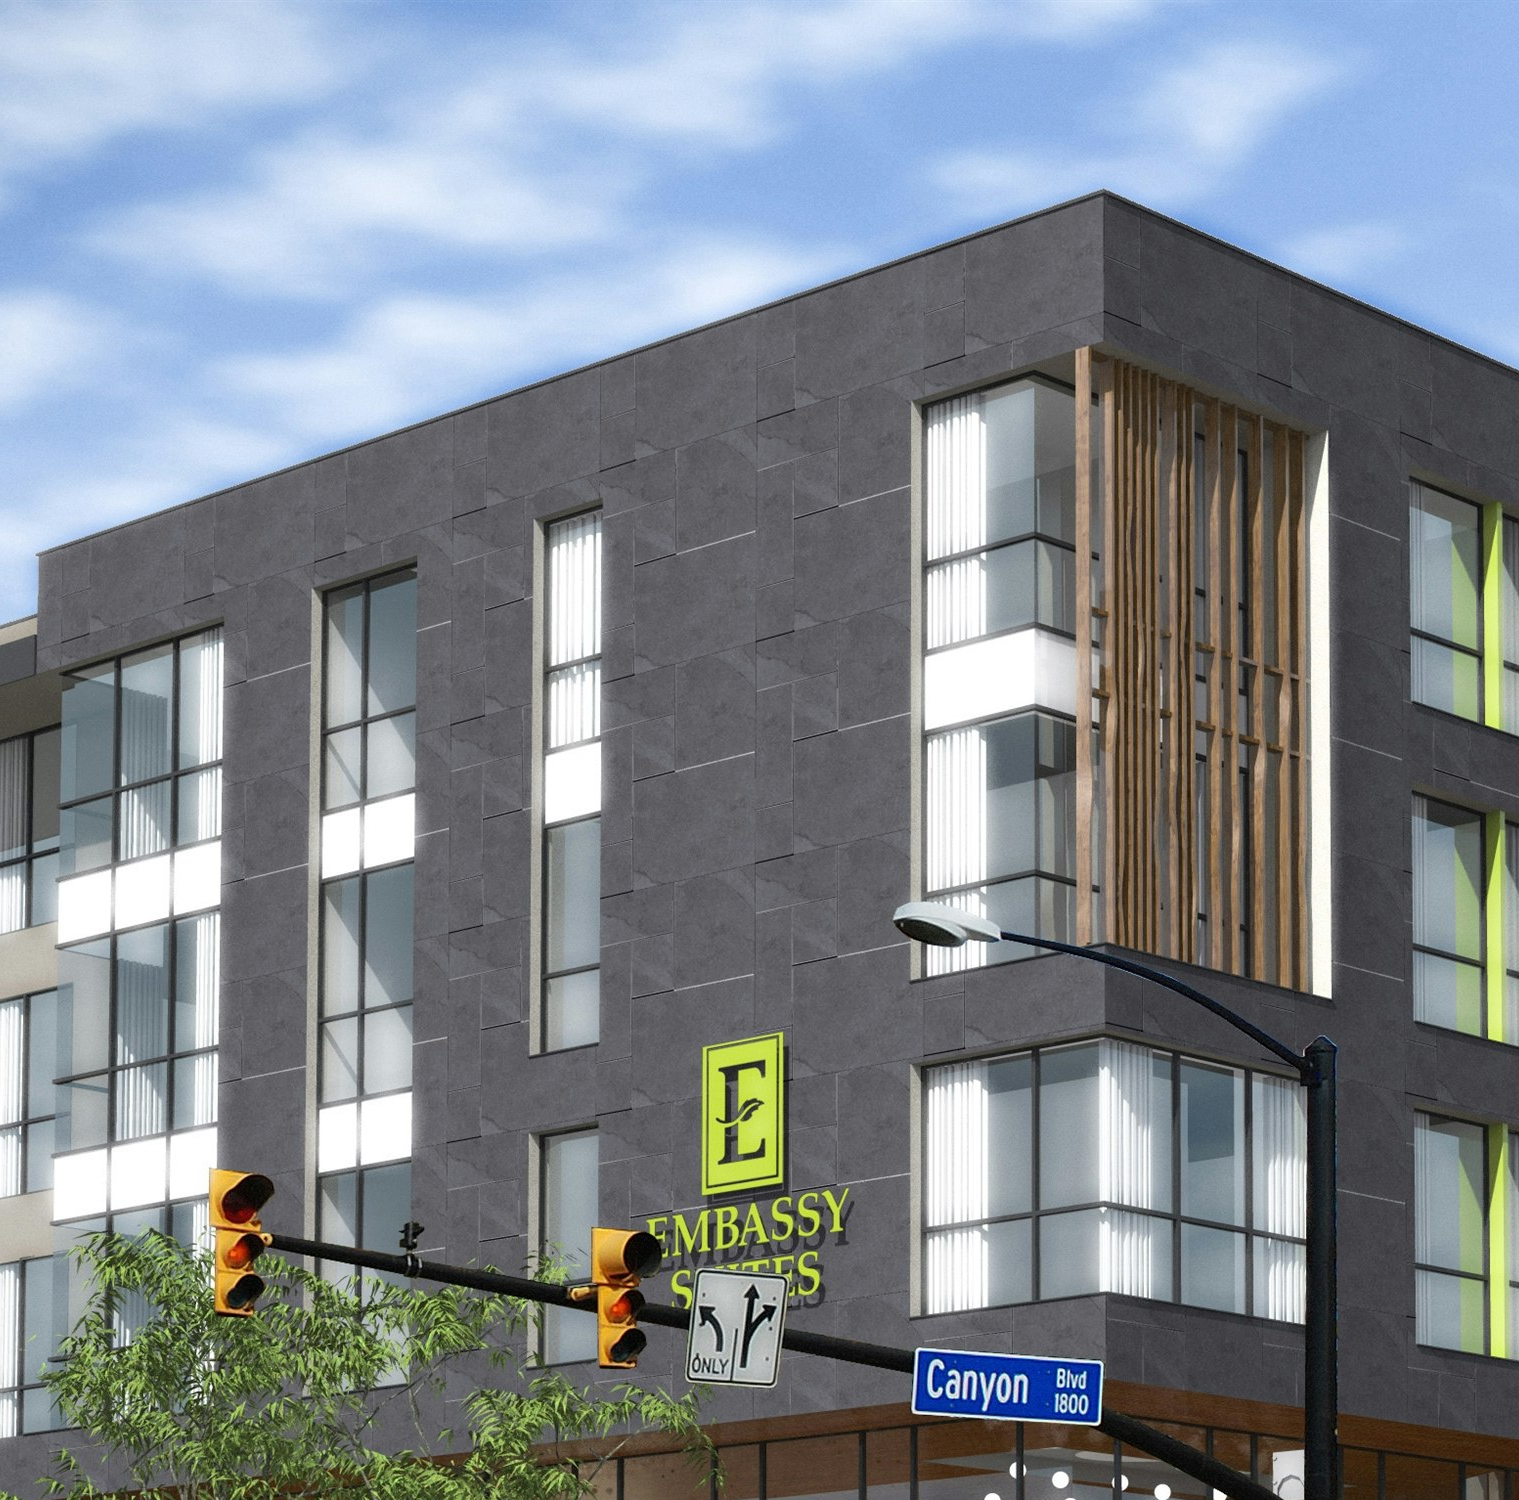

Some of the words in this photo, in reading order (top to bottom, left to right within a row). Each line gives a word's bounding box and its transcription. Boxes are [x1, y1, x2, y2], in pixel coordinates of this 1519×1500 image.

[646, 1187, 850, 1259] EMBASSY
[670, 1251, 821, 1310] SES
[691, 1356, 729, 1375] ONLY
[926, 1358, 1030, 1412] Canyon
[1055, 1367, 1088, 1390] Blvd
[1054, 1392, 1090, 1416] 1800
